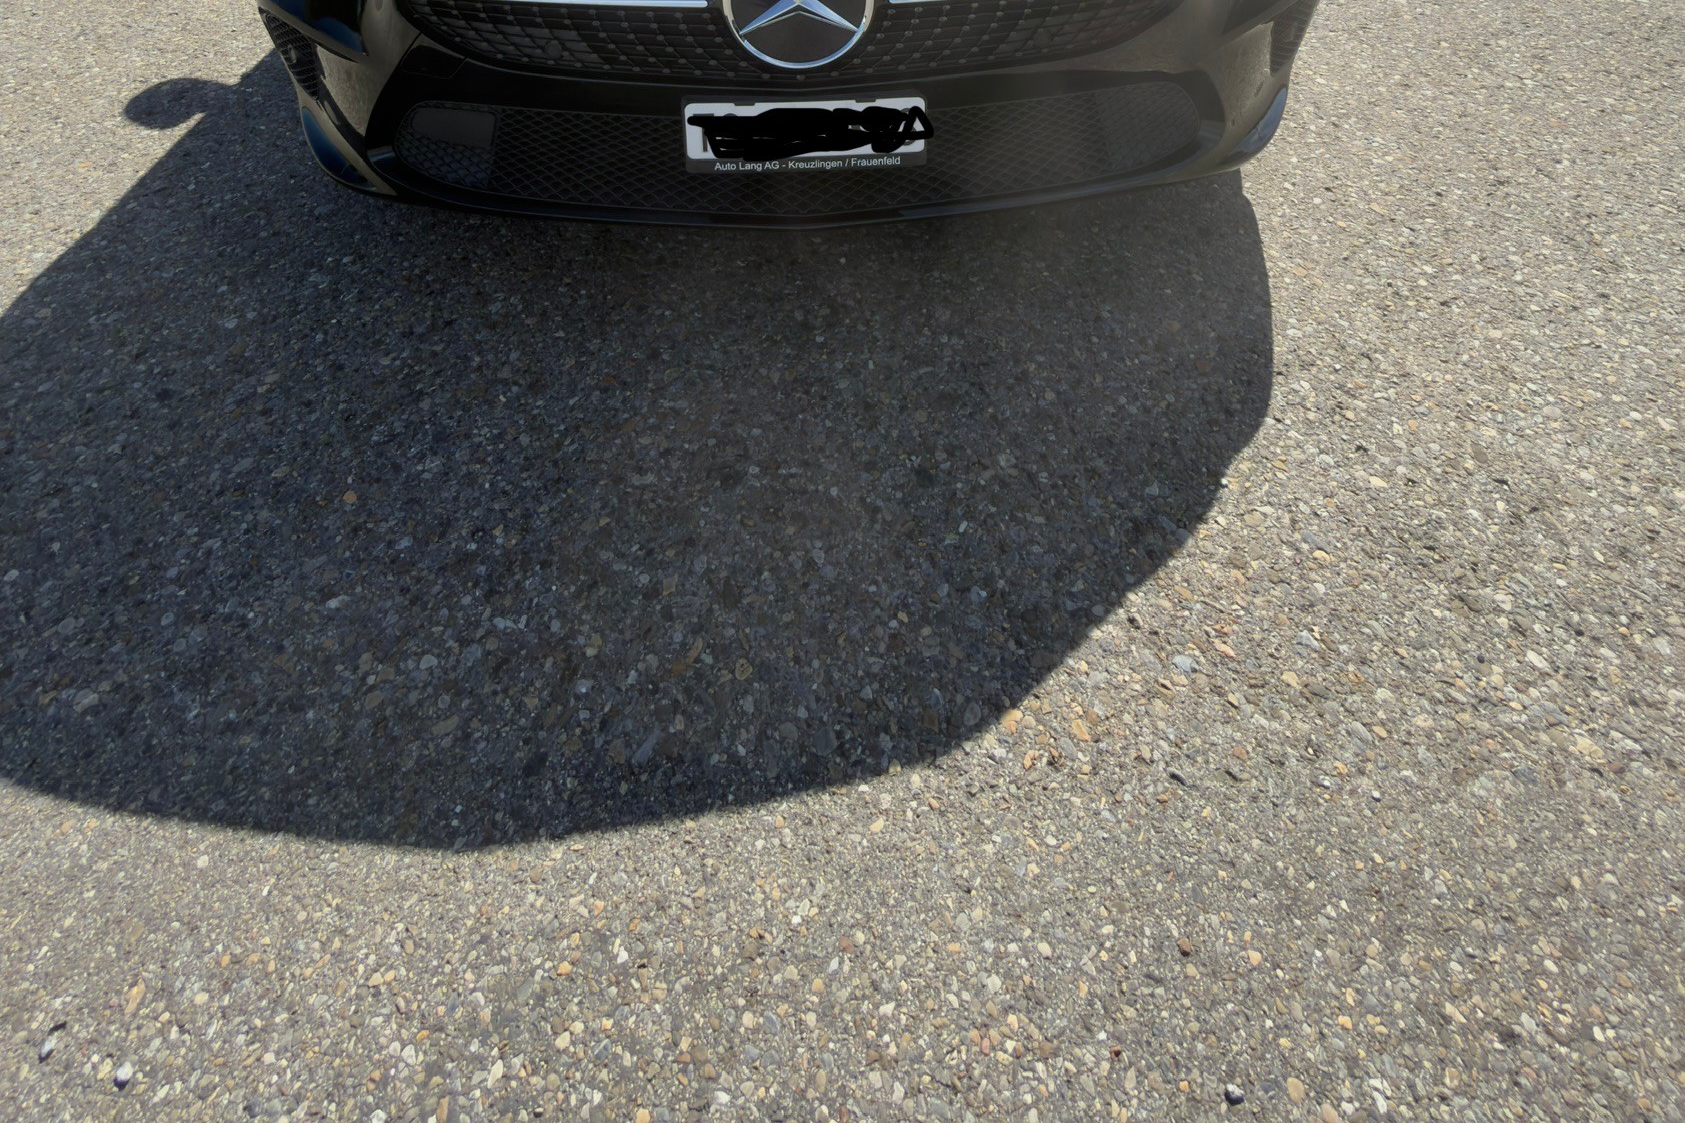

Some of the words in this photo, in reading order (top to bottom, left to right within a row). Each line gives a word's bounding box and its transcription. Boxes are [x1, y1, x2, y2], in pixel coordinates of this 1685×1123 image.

[714, 162, 737, 171] Auto
[739, 161, 763, 172] Lang
[764, 161, 780, 170] AG
[788, 159, 843, 170] Kreuzlingen
[851, 156, 901, 167] Frauenfeld
